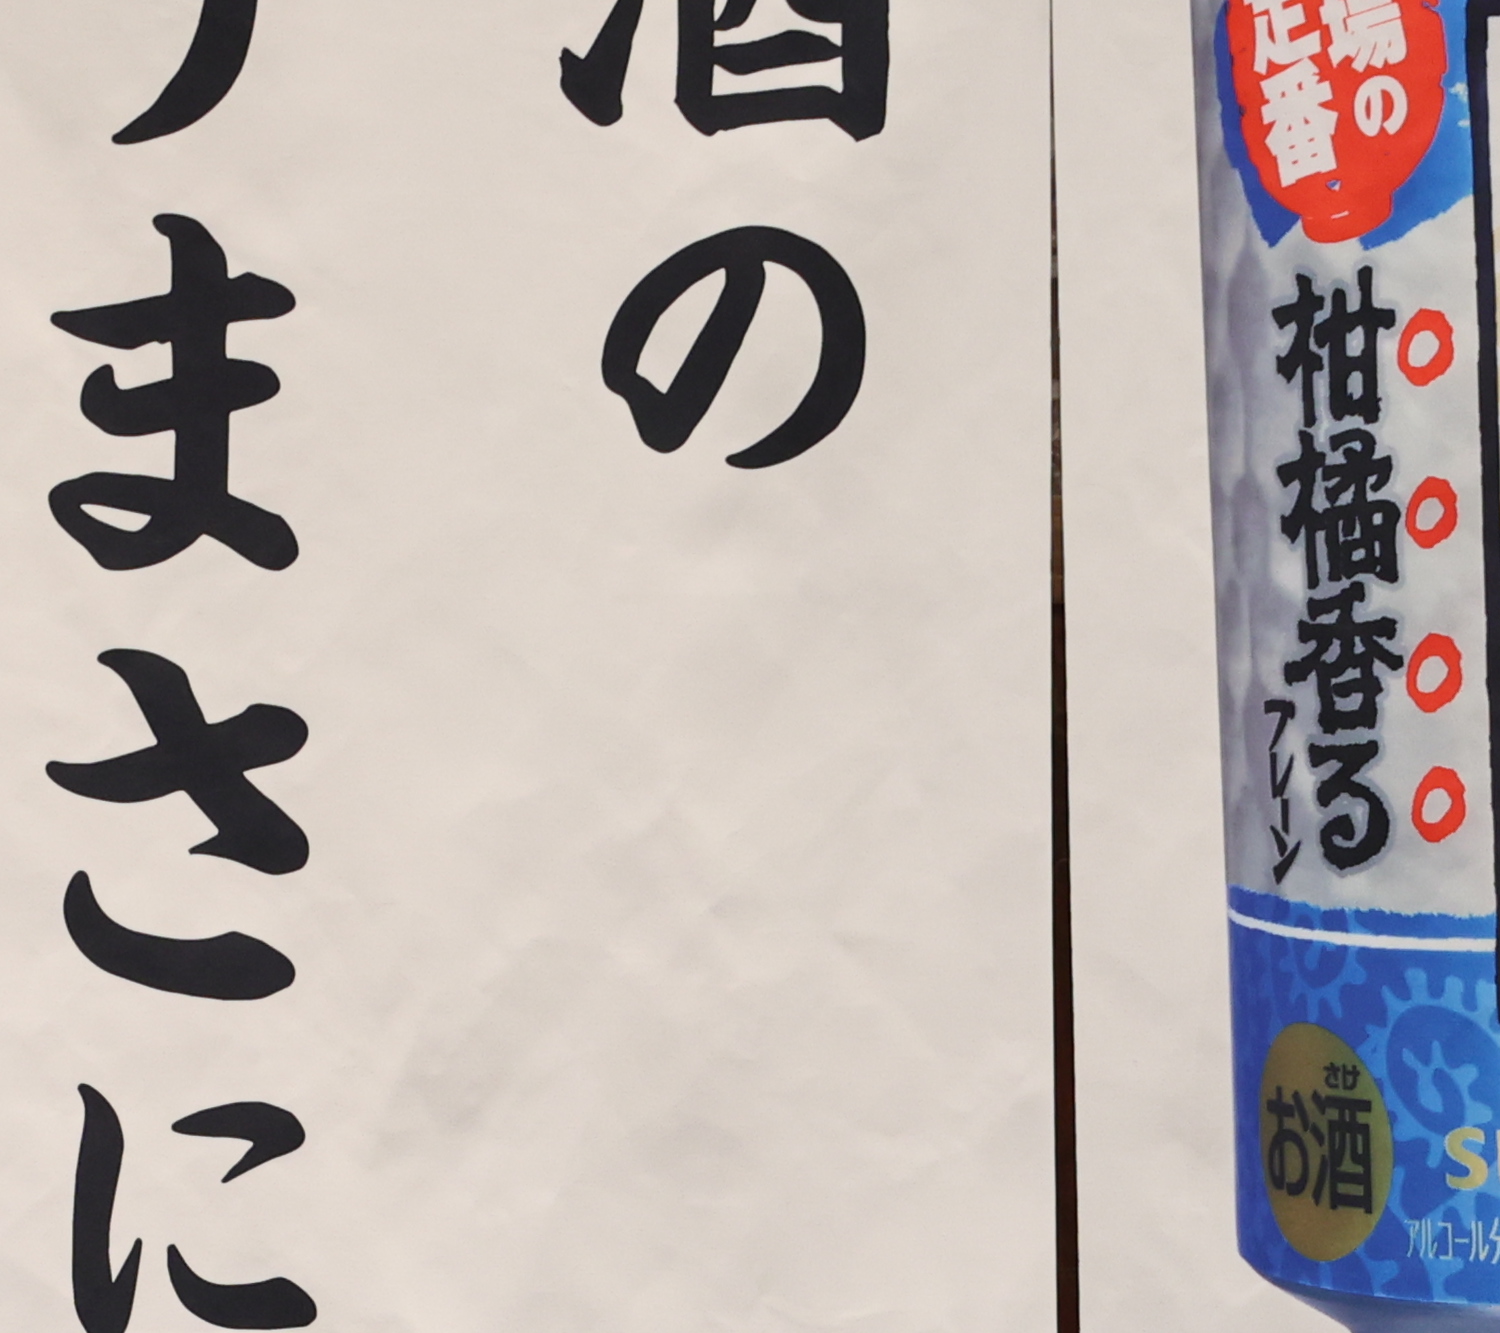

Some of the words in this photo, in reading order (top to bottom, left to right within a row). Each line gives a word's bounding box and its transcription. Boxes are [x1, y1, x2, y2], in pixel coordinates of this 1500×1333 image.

[1274, 265, 1405, 874] 柑橘香る
[1323, 1061, 1360, 1089] さけ
[1266, 1086, 1376, 1217] お酒
